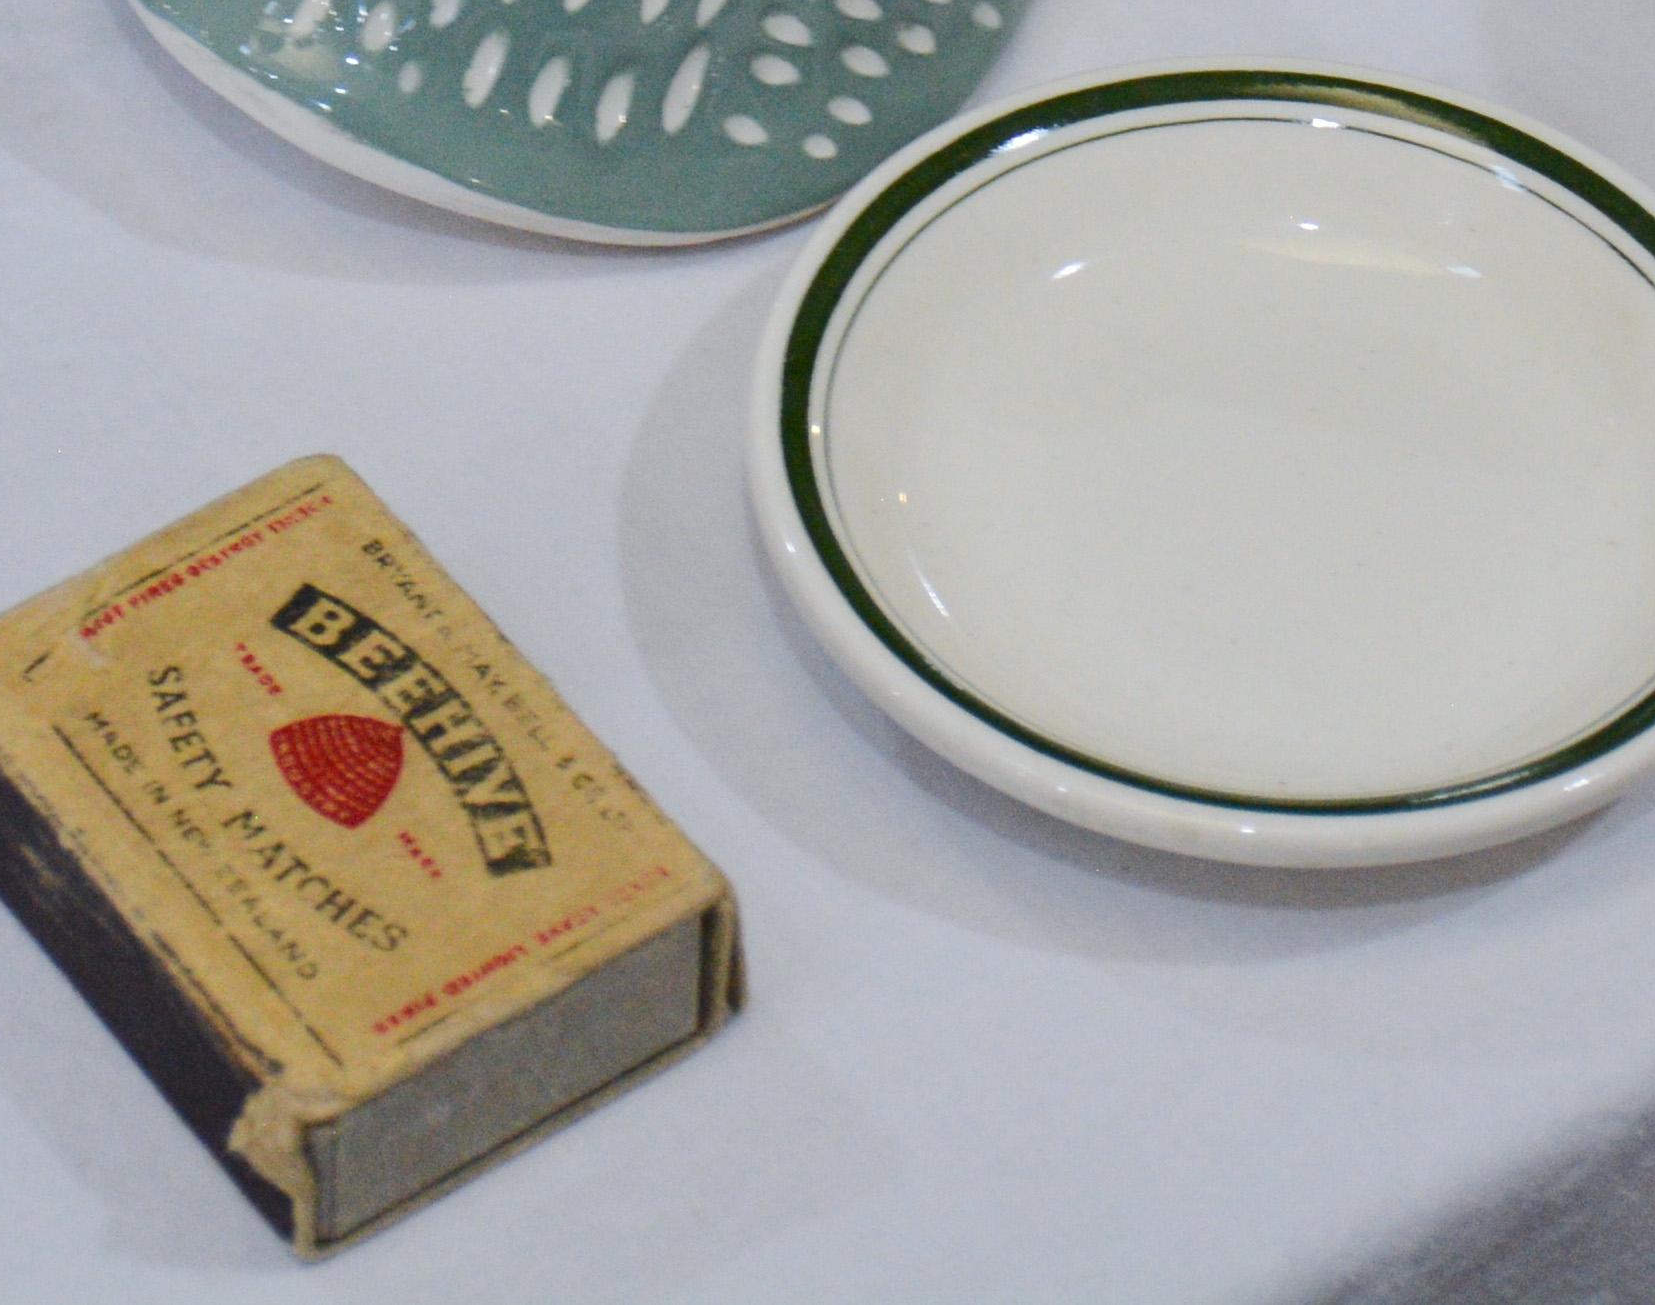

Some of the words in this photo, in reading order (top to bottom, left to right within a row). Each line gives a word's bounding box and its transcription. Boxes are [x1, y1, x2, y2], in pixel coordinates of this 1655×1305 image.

[83, 710, 145, 775] MADE
[143, 779, 171, 807] IN
[233, 642, 284, 697] TRADE
[288, 594, 538, 864] BEEHIVE
[146, 664, 234, 793] SAFETY
[222, 808, 410, 953] MATCHES
